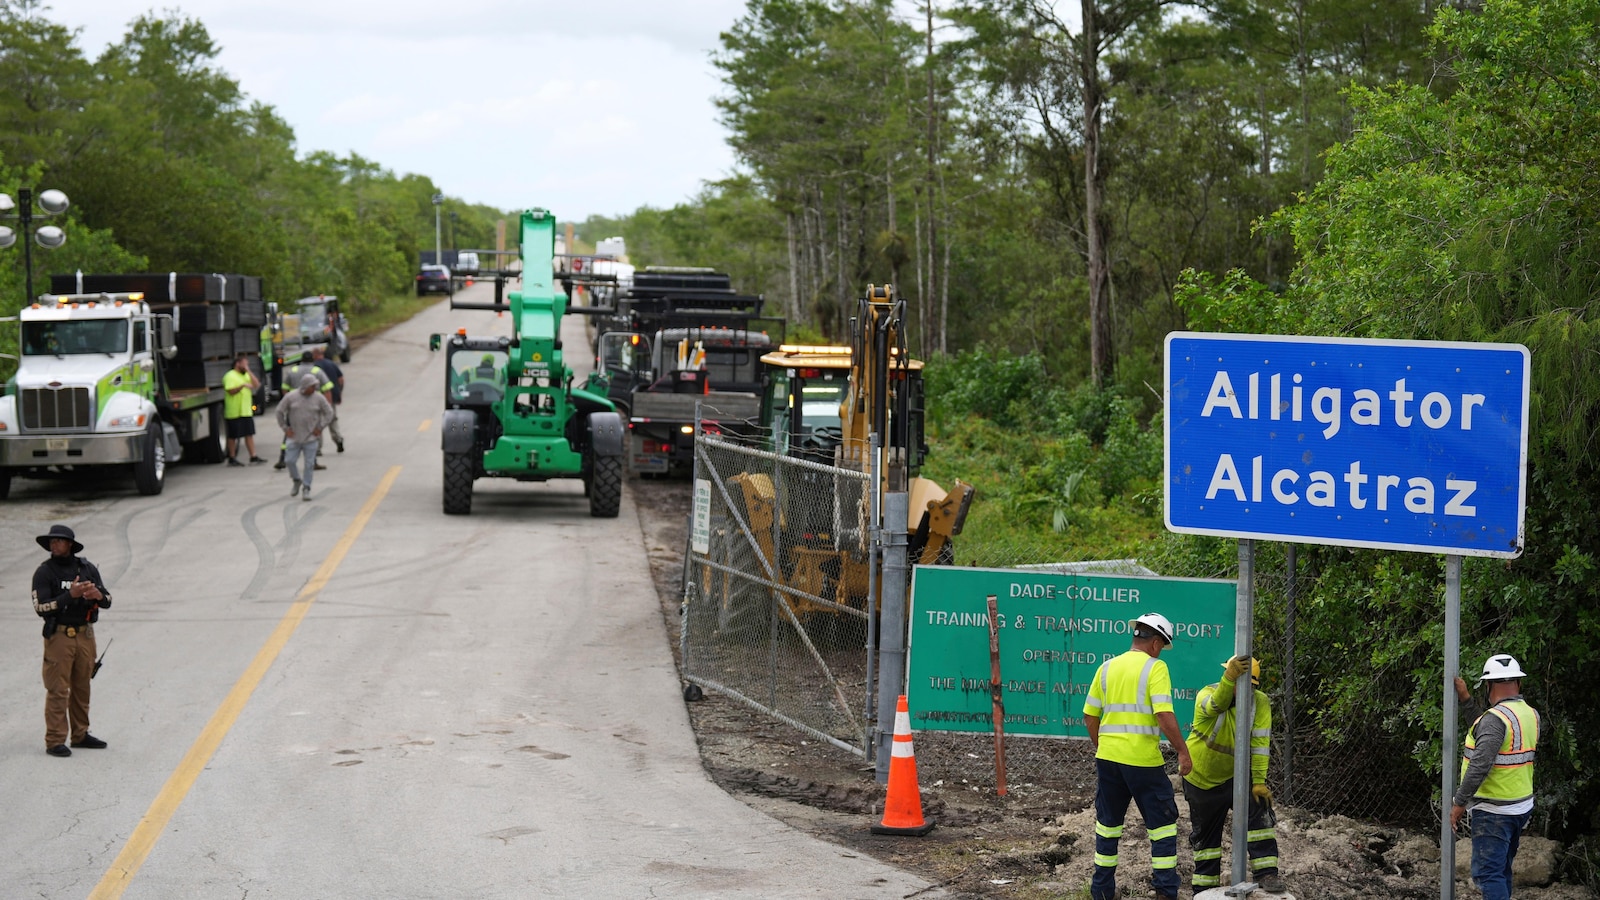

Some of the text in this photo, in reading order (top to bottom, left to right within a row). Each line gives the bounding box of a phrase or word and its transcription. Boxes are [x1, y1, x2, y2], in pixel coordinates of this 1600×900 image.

[523, 369, 550, 377] JCB
[1201, 371, 1486, 440] Alligator
[1205, 453, 1477, 517] Alcatraz
[1010, 583, 1140, 603] DADE-COLLIER
[1014, 614, 1025, 629] &
[1023, 649, 1097, 664] OPERATED
[929, 676, 955, 689] THE
[1052, 682, 1089, 695] AVIAT
